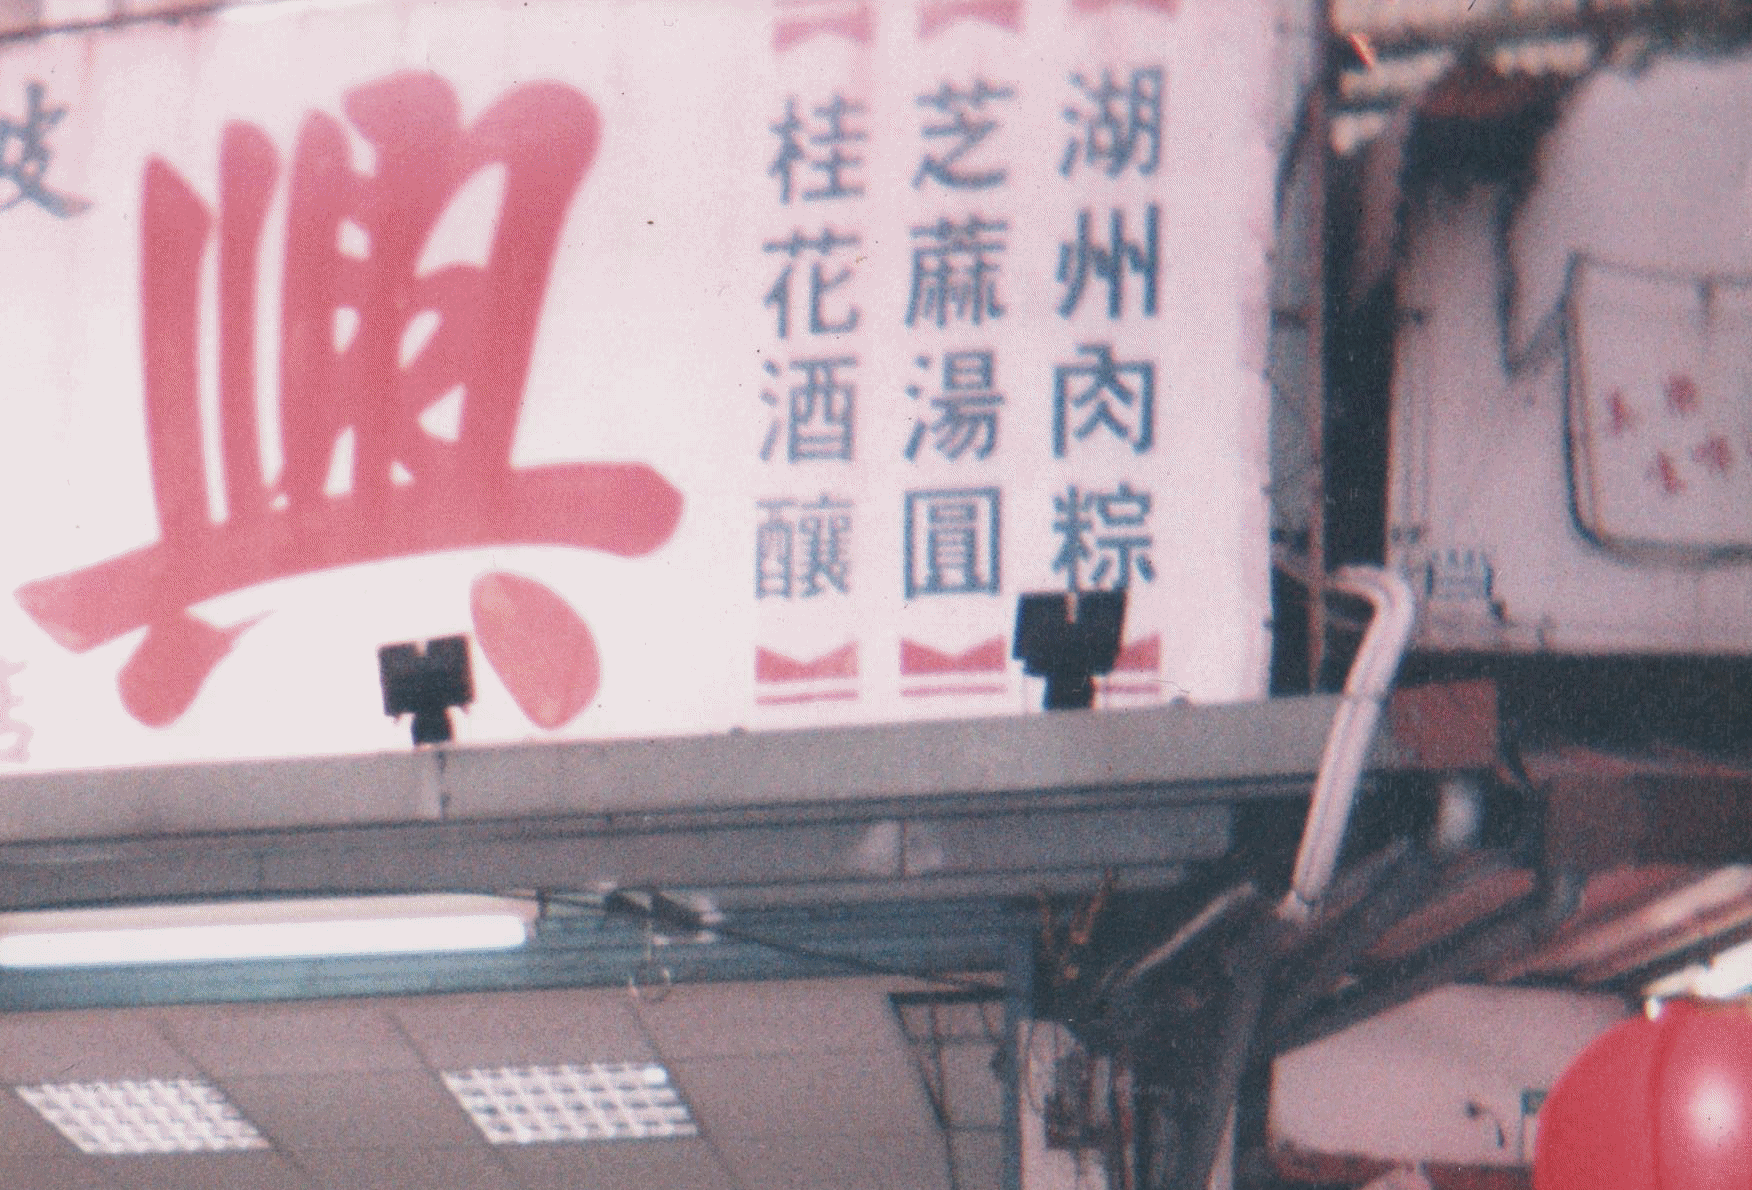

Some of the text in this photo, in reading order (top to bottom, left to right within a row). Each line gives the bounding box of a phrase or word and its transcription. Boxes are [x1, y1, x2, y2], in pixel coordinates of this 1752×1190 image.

[754, 93, 870, 602] 桂花酒釀
[1049, 65, 1166, 592] 湖州肉粽
